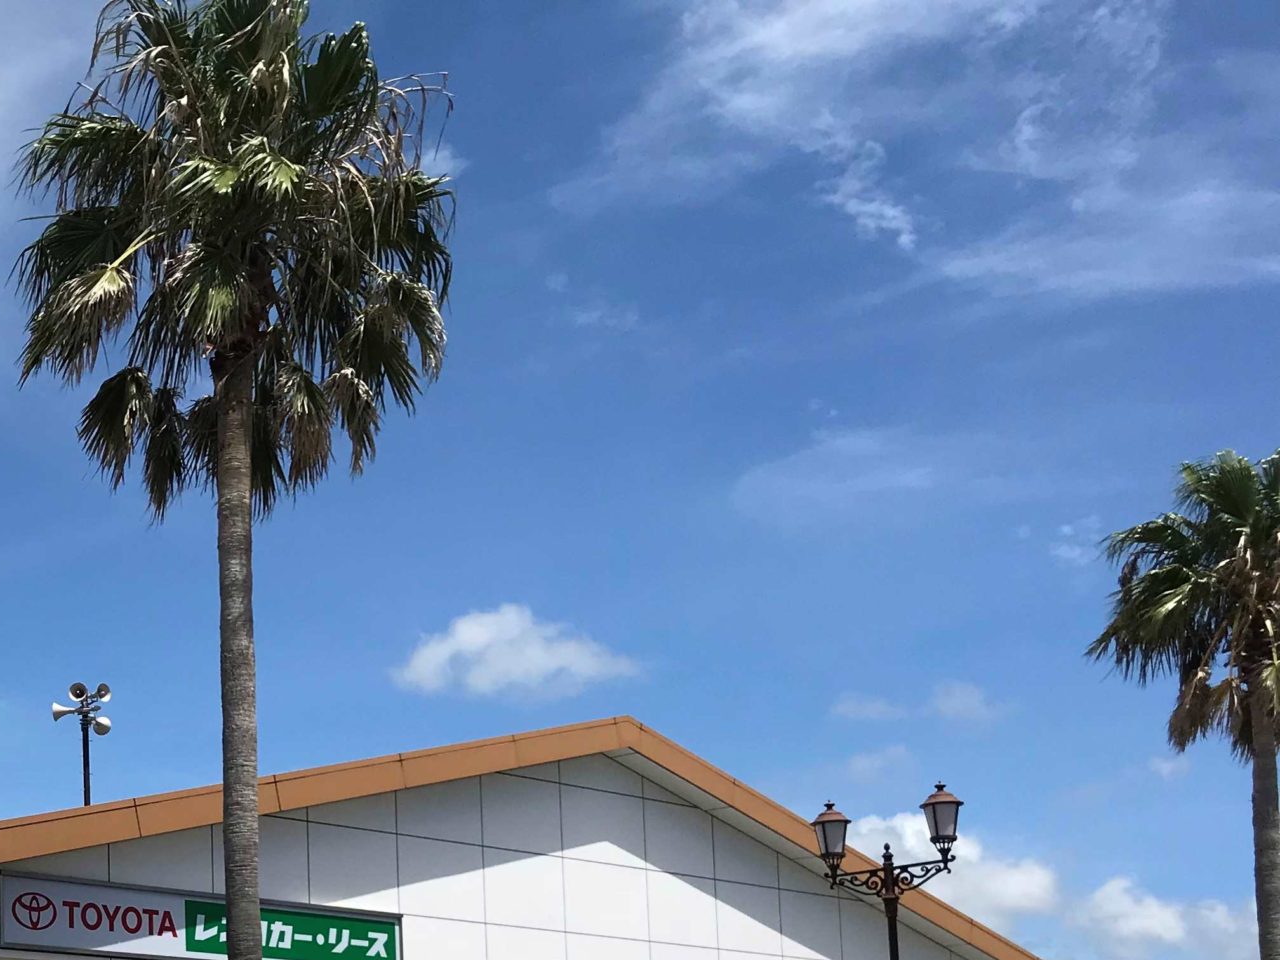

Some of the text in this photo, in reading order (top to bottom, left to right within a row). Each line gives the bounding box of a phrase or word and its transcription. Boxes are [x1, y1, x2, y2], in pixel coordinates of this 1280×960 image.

[62, 900, 389, 959] TOYOTA レカー・リース
